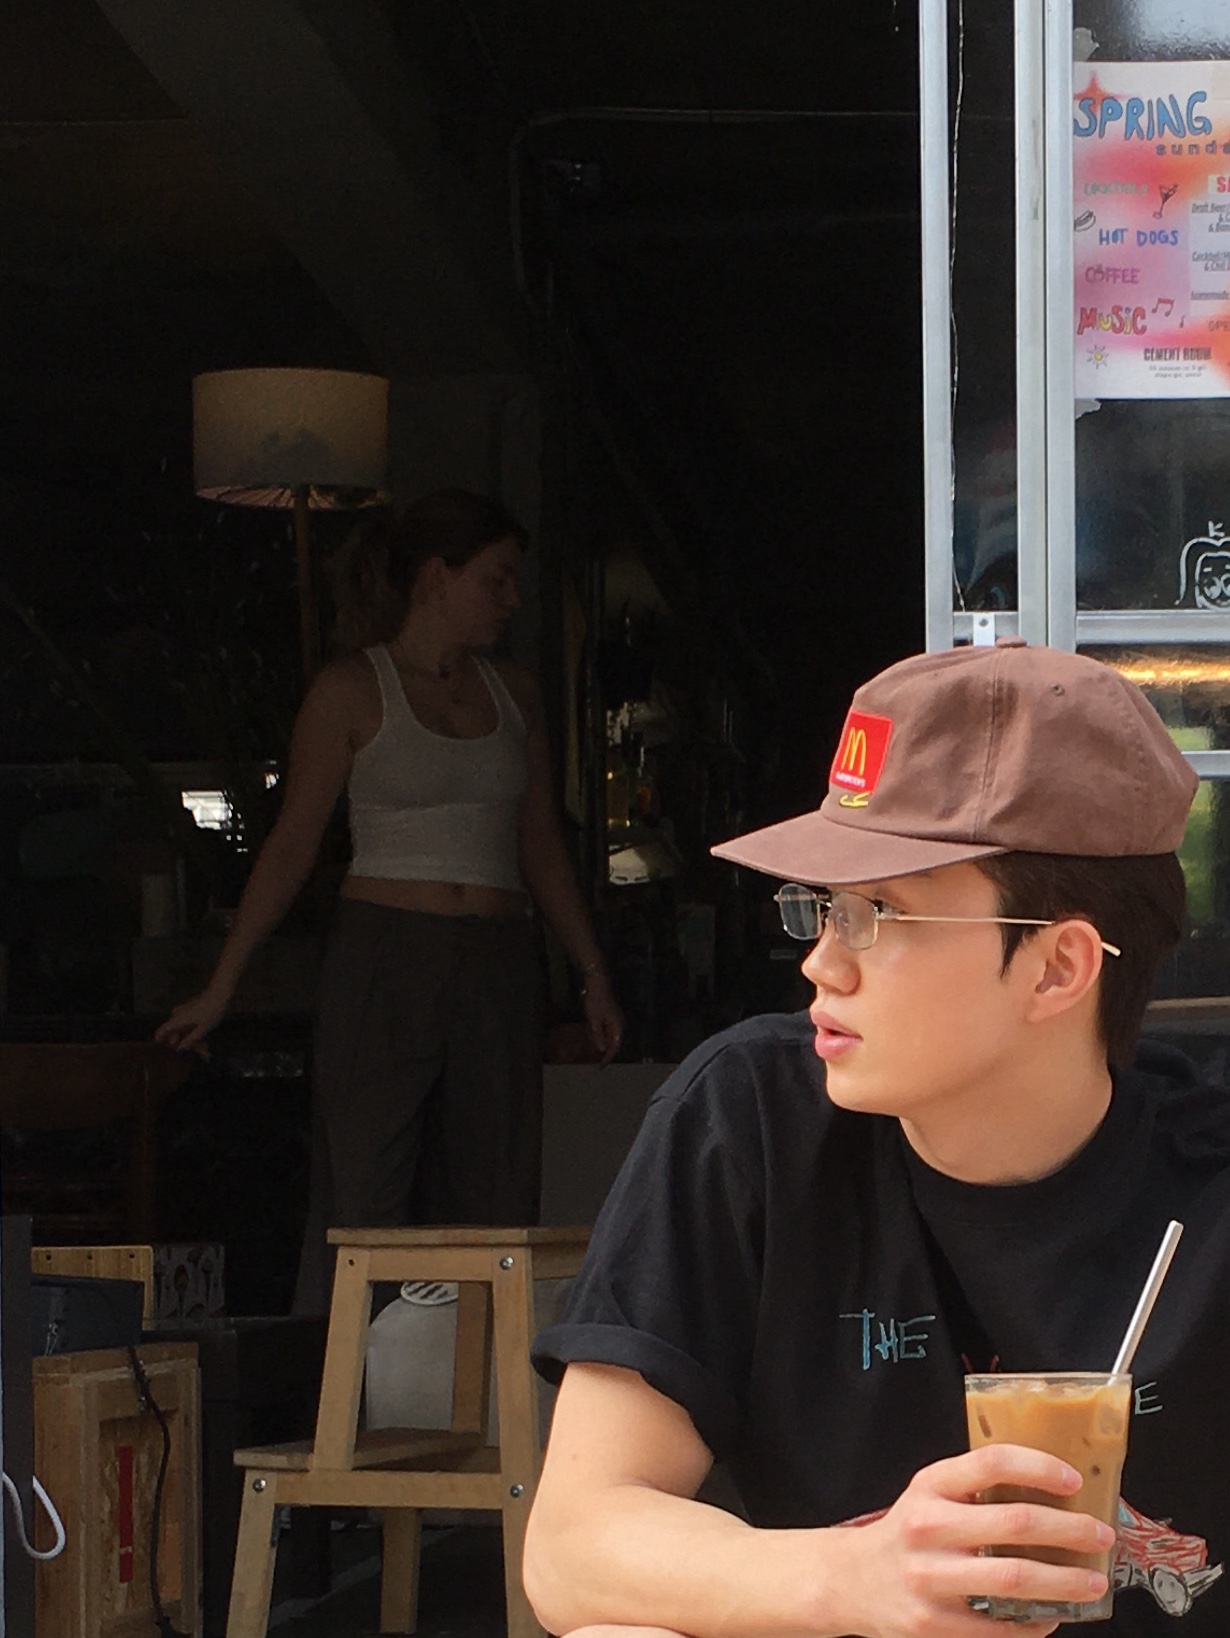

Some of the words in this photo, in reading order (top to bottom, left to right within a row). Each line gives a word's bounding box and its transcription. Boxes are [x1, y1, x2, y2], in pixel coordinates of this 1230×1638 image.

[1074, 91, 1212, 140] SPRING
[1099, 228, 1128, 246] HOT
[1136, 229, 1179, 247] DOGS
[1084, 264, 1140, 284] COFFEE
[1208, 520, 1225, 537] K
[839, 1308, 936, 1370] THE
